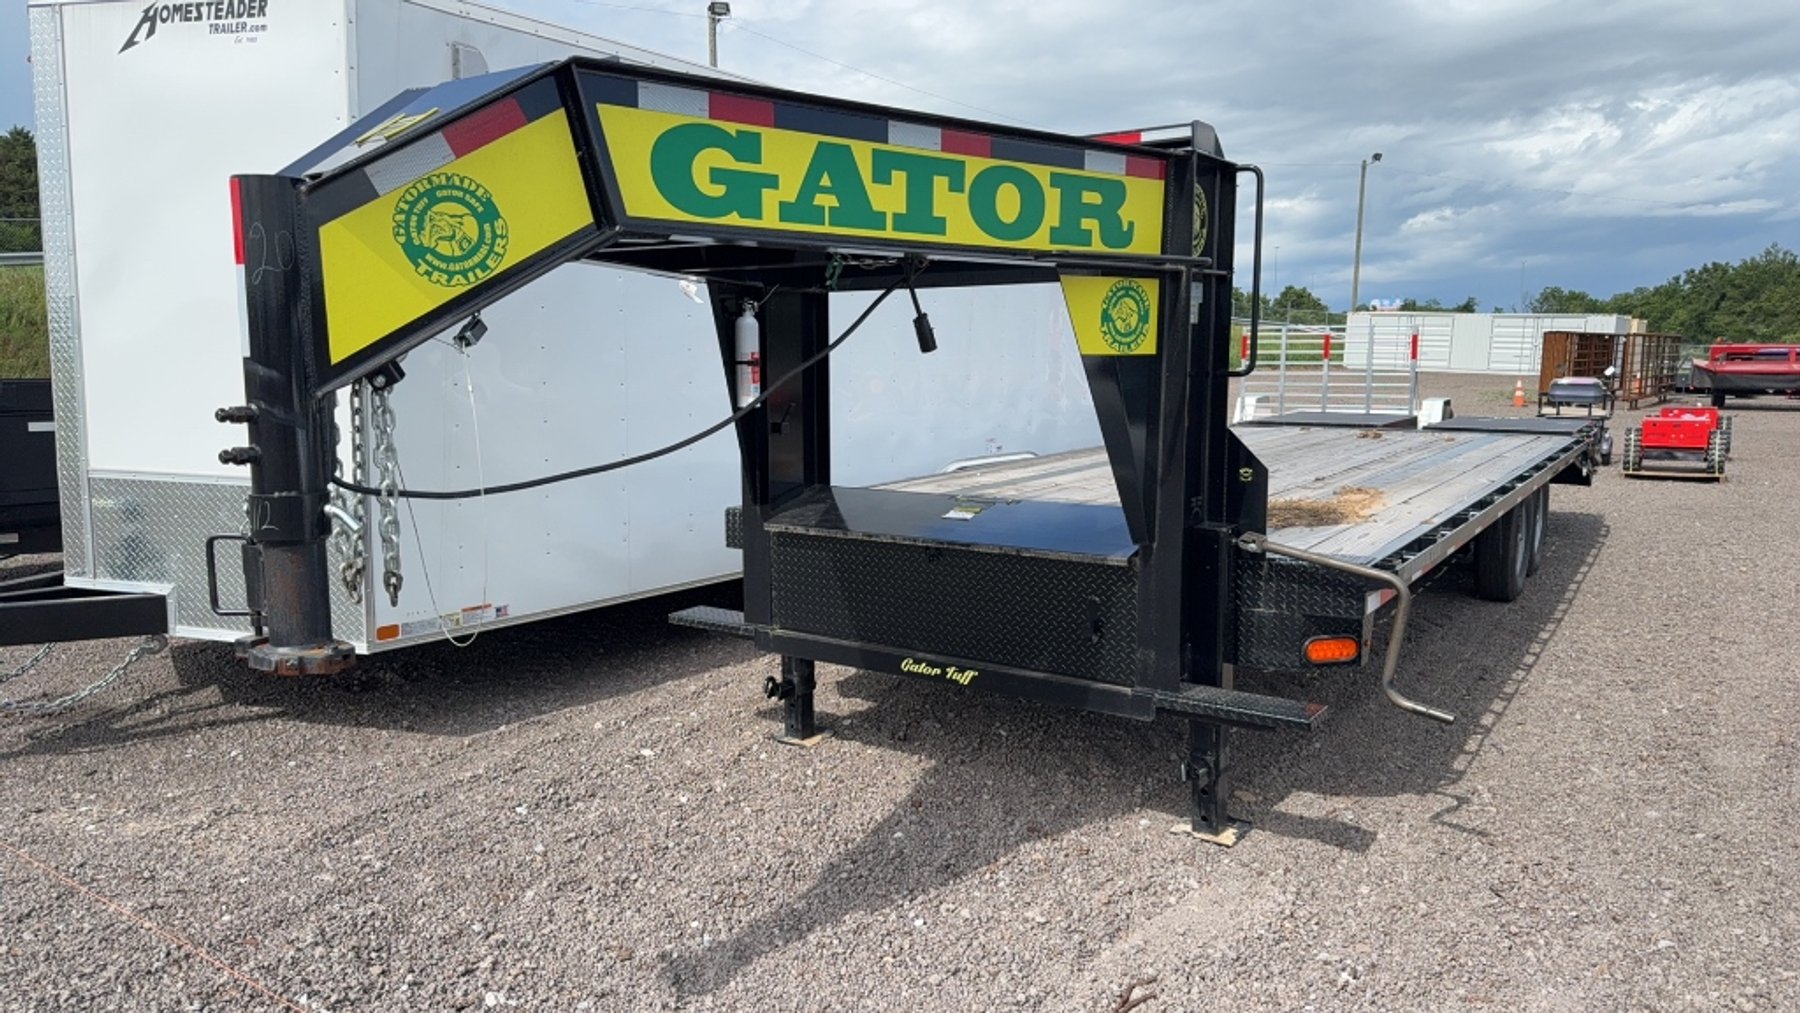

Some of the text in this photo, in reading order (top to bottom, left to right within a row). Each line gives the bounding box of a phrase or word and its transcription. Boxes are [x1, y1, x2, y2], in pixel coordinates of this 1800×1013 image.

[118, 0, 268, 54] HOMESTEADER
[392, 172, 493, 245] GATORMADE
[649, 122, 1136, 249] GATOR
[416, 216, 510, 287] TRAILERS
[900, 657, 979, 686] Gator Tuff
